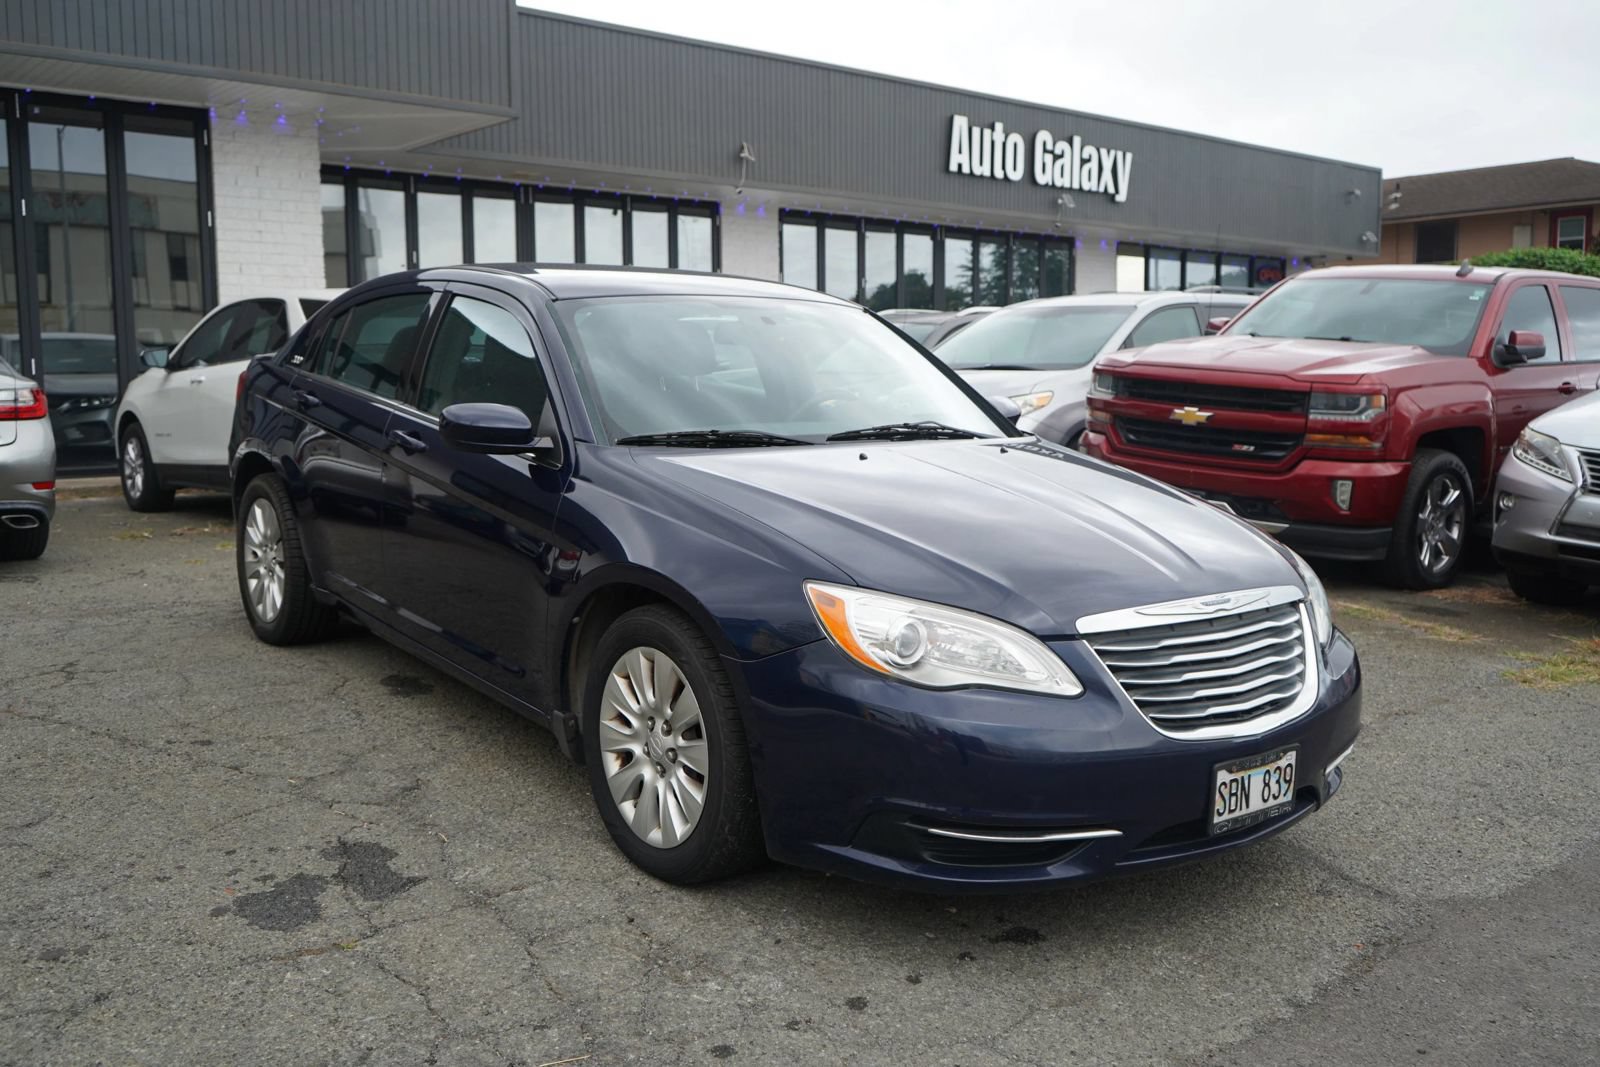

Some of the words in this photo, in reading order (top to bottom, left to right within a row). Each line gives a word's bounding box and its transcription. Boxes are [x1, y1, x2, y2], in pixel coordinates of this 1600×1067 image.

[949, 114, 1025, 181] Auto
[1034, 129, 1133, 202] Galaxy
[1216, 774, 1251, 817] SBN
[1261, 763, 1293, 803] 839
